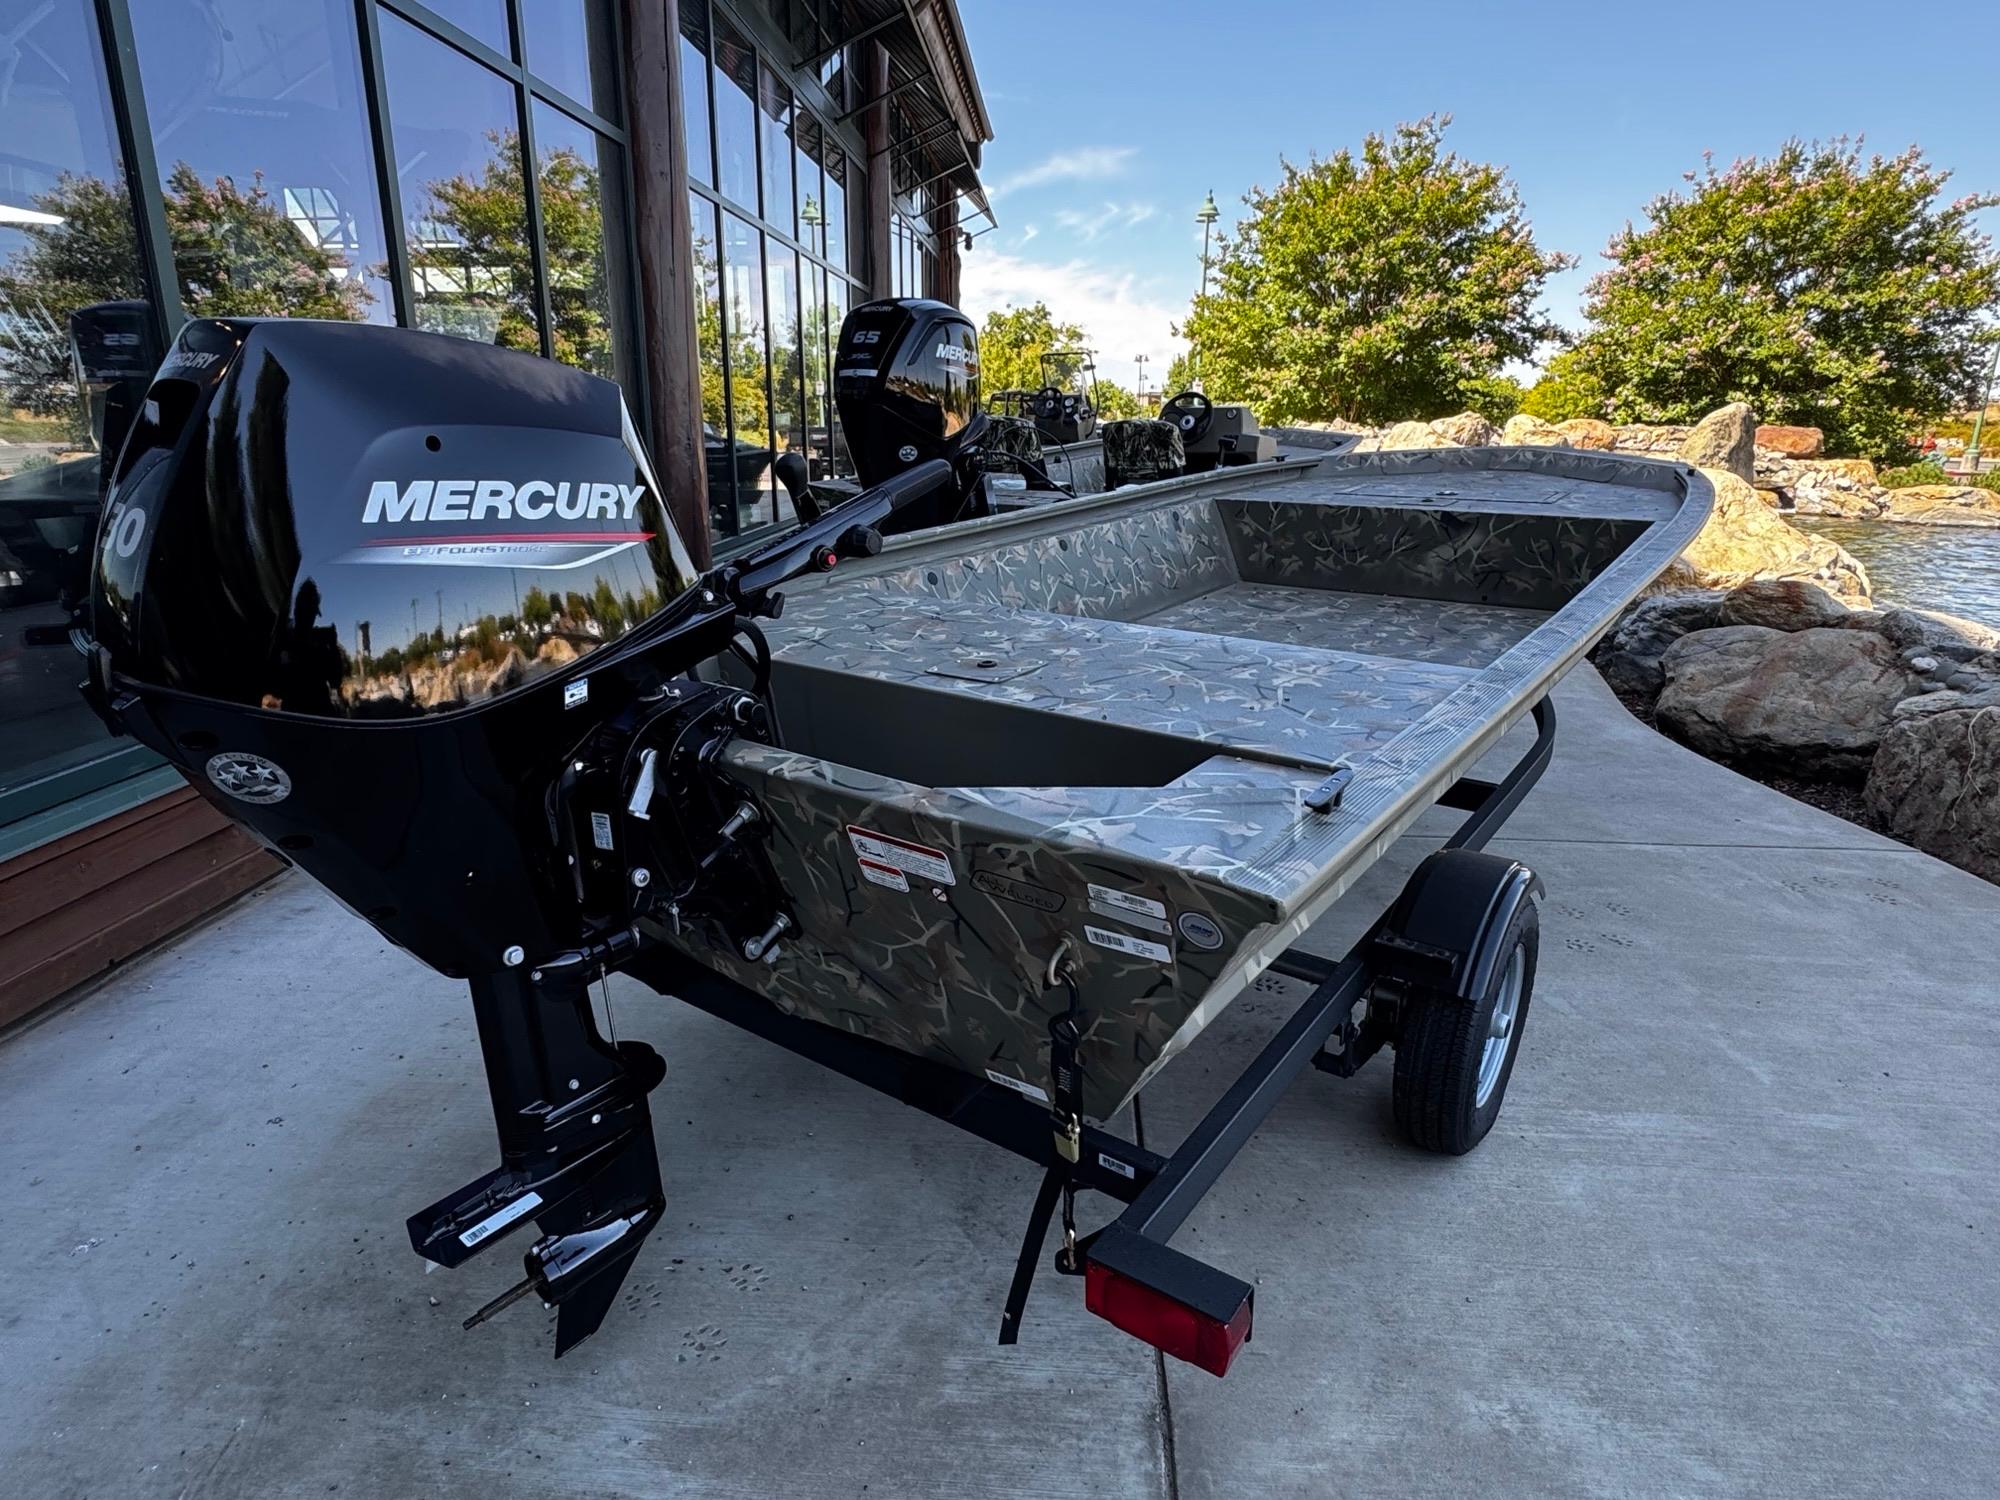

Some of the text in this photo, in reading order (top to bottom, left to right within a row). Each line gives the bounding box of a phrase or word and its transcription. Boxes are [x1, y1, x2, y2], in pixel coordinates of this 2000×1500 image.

[852, 330, 881, 344] 65
[936, 343, 978, 365] MERCUR
[362, 480, 646, 523] MERCURY
